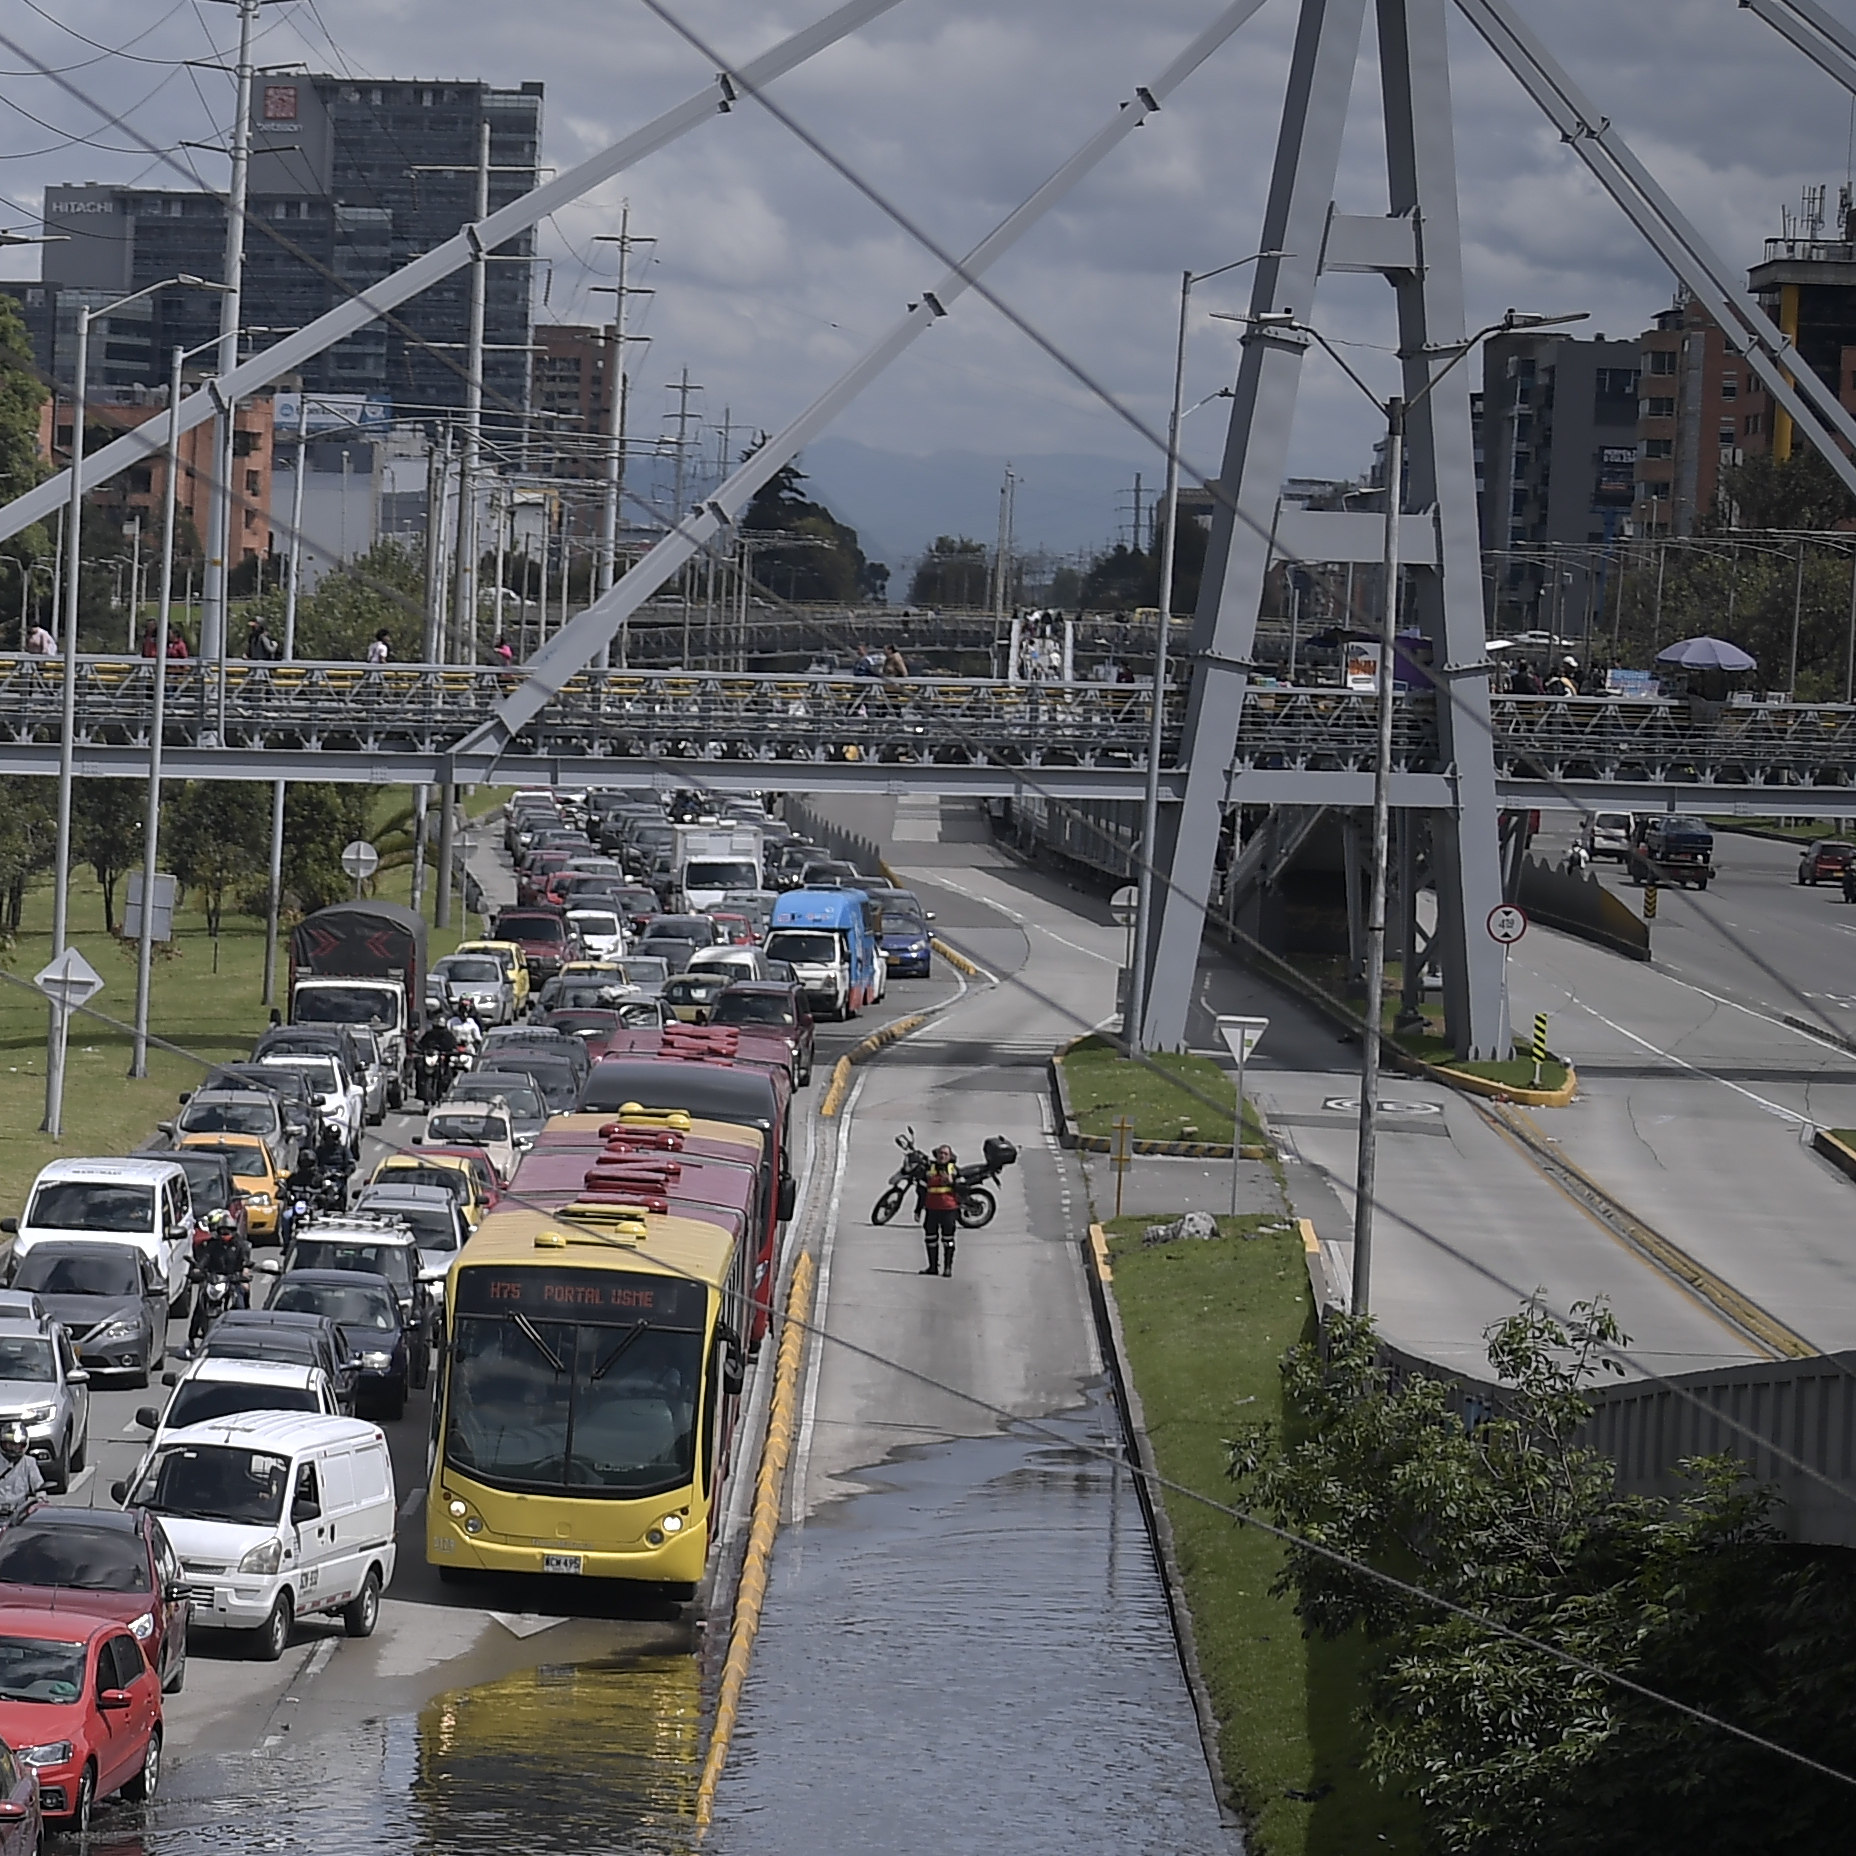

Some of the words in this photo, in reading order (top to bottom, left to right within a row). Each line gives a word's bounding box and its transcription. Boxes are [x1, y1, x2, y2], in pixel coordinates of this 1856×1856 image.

[490, 1282, 522, 1299] H75
[544, 1284, 604, 1304] PORTAL
[611, 1288, 654, 1307] USME
